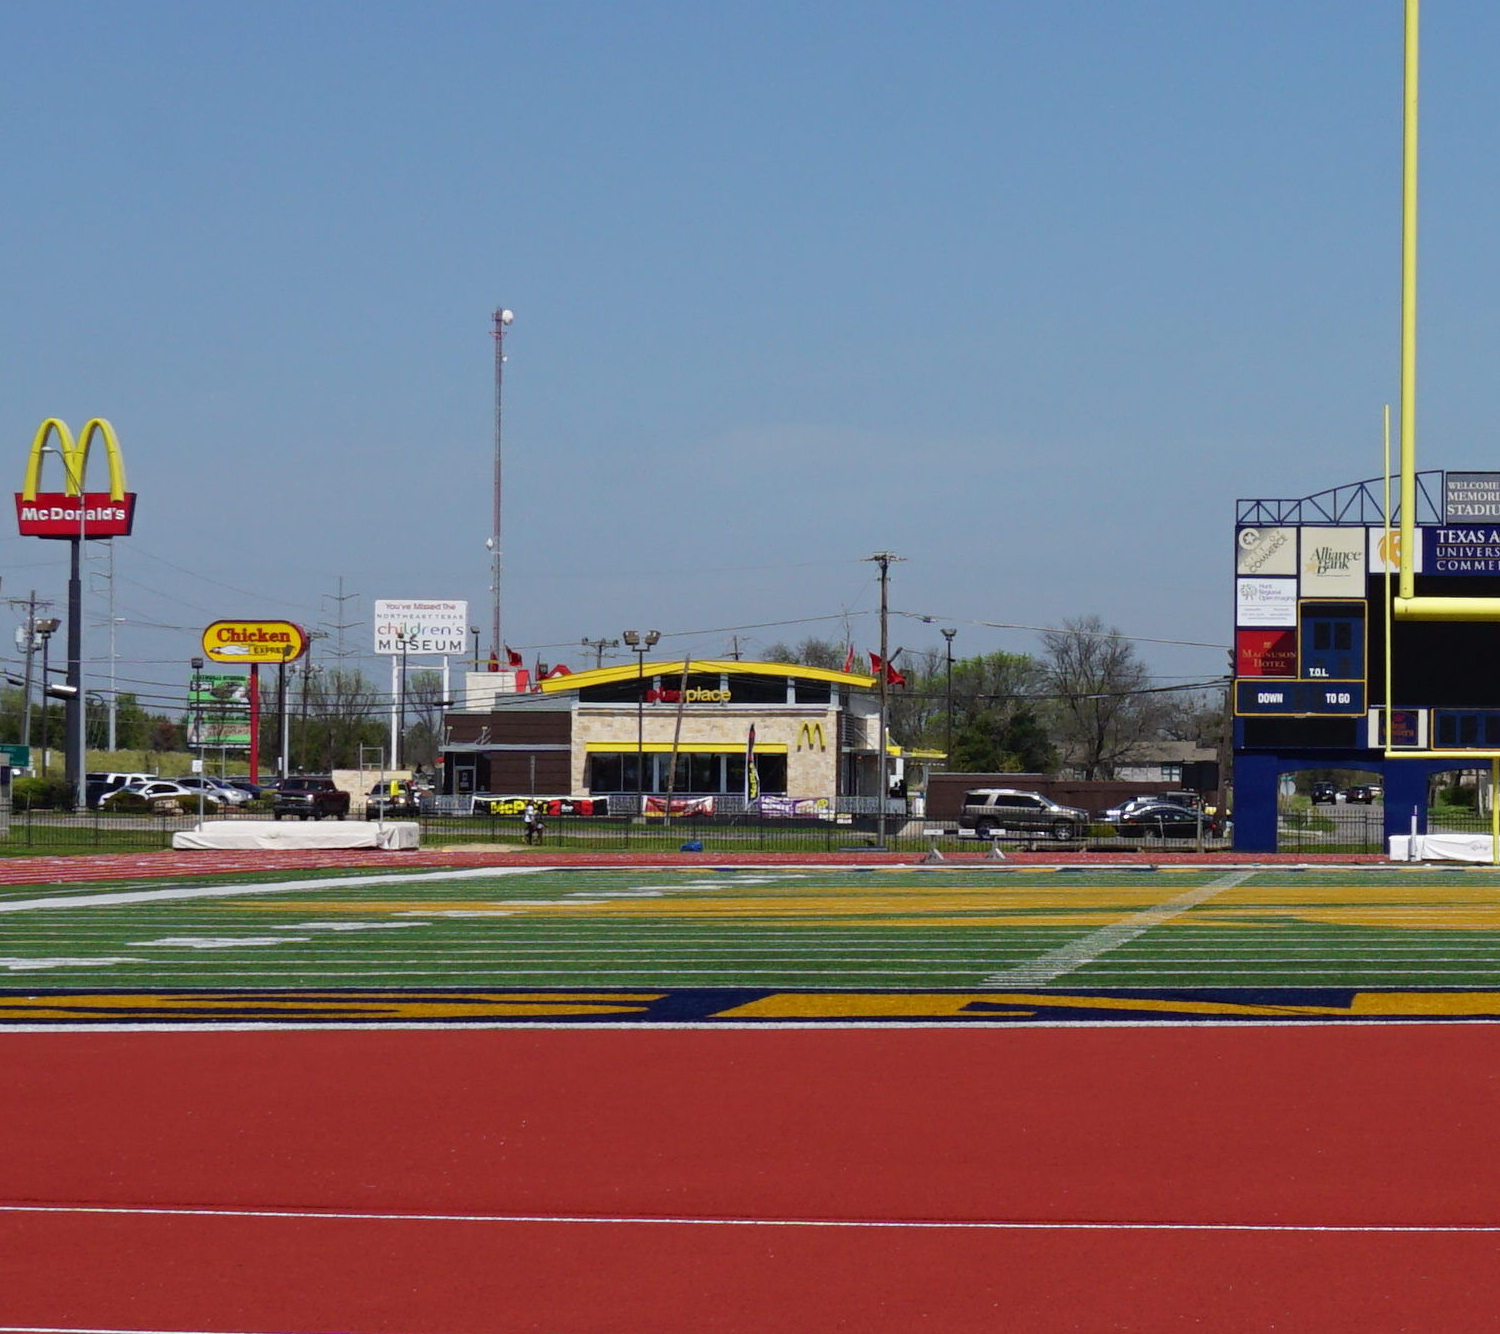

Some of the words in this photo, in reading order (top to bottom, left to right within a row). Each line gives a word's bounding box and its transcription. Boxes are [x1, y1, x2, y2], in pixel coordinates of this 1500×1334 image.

[1447, 481, 1499, 490] WELCOME
[1436, 530, 1485, 543] TEXAS
[1310, 547, 1362, 562] Alliance
[1316, 559, 1350, 575] Bank
[377, 622, 464, 635] children's
[217, 628, 291, 642] Chicken
[378, 639, 462, 651] MUSEUM
[1309, 668, 1329, 677] T.O.L.
[1258, 693, 1283, 703] DOWN
[1325, 693, 1336, 703] TO
[1338, 693, 1350, 704] GO
